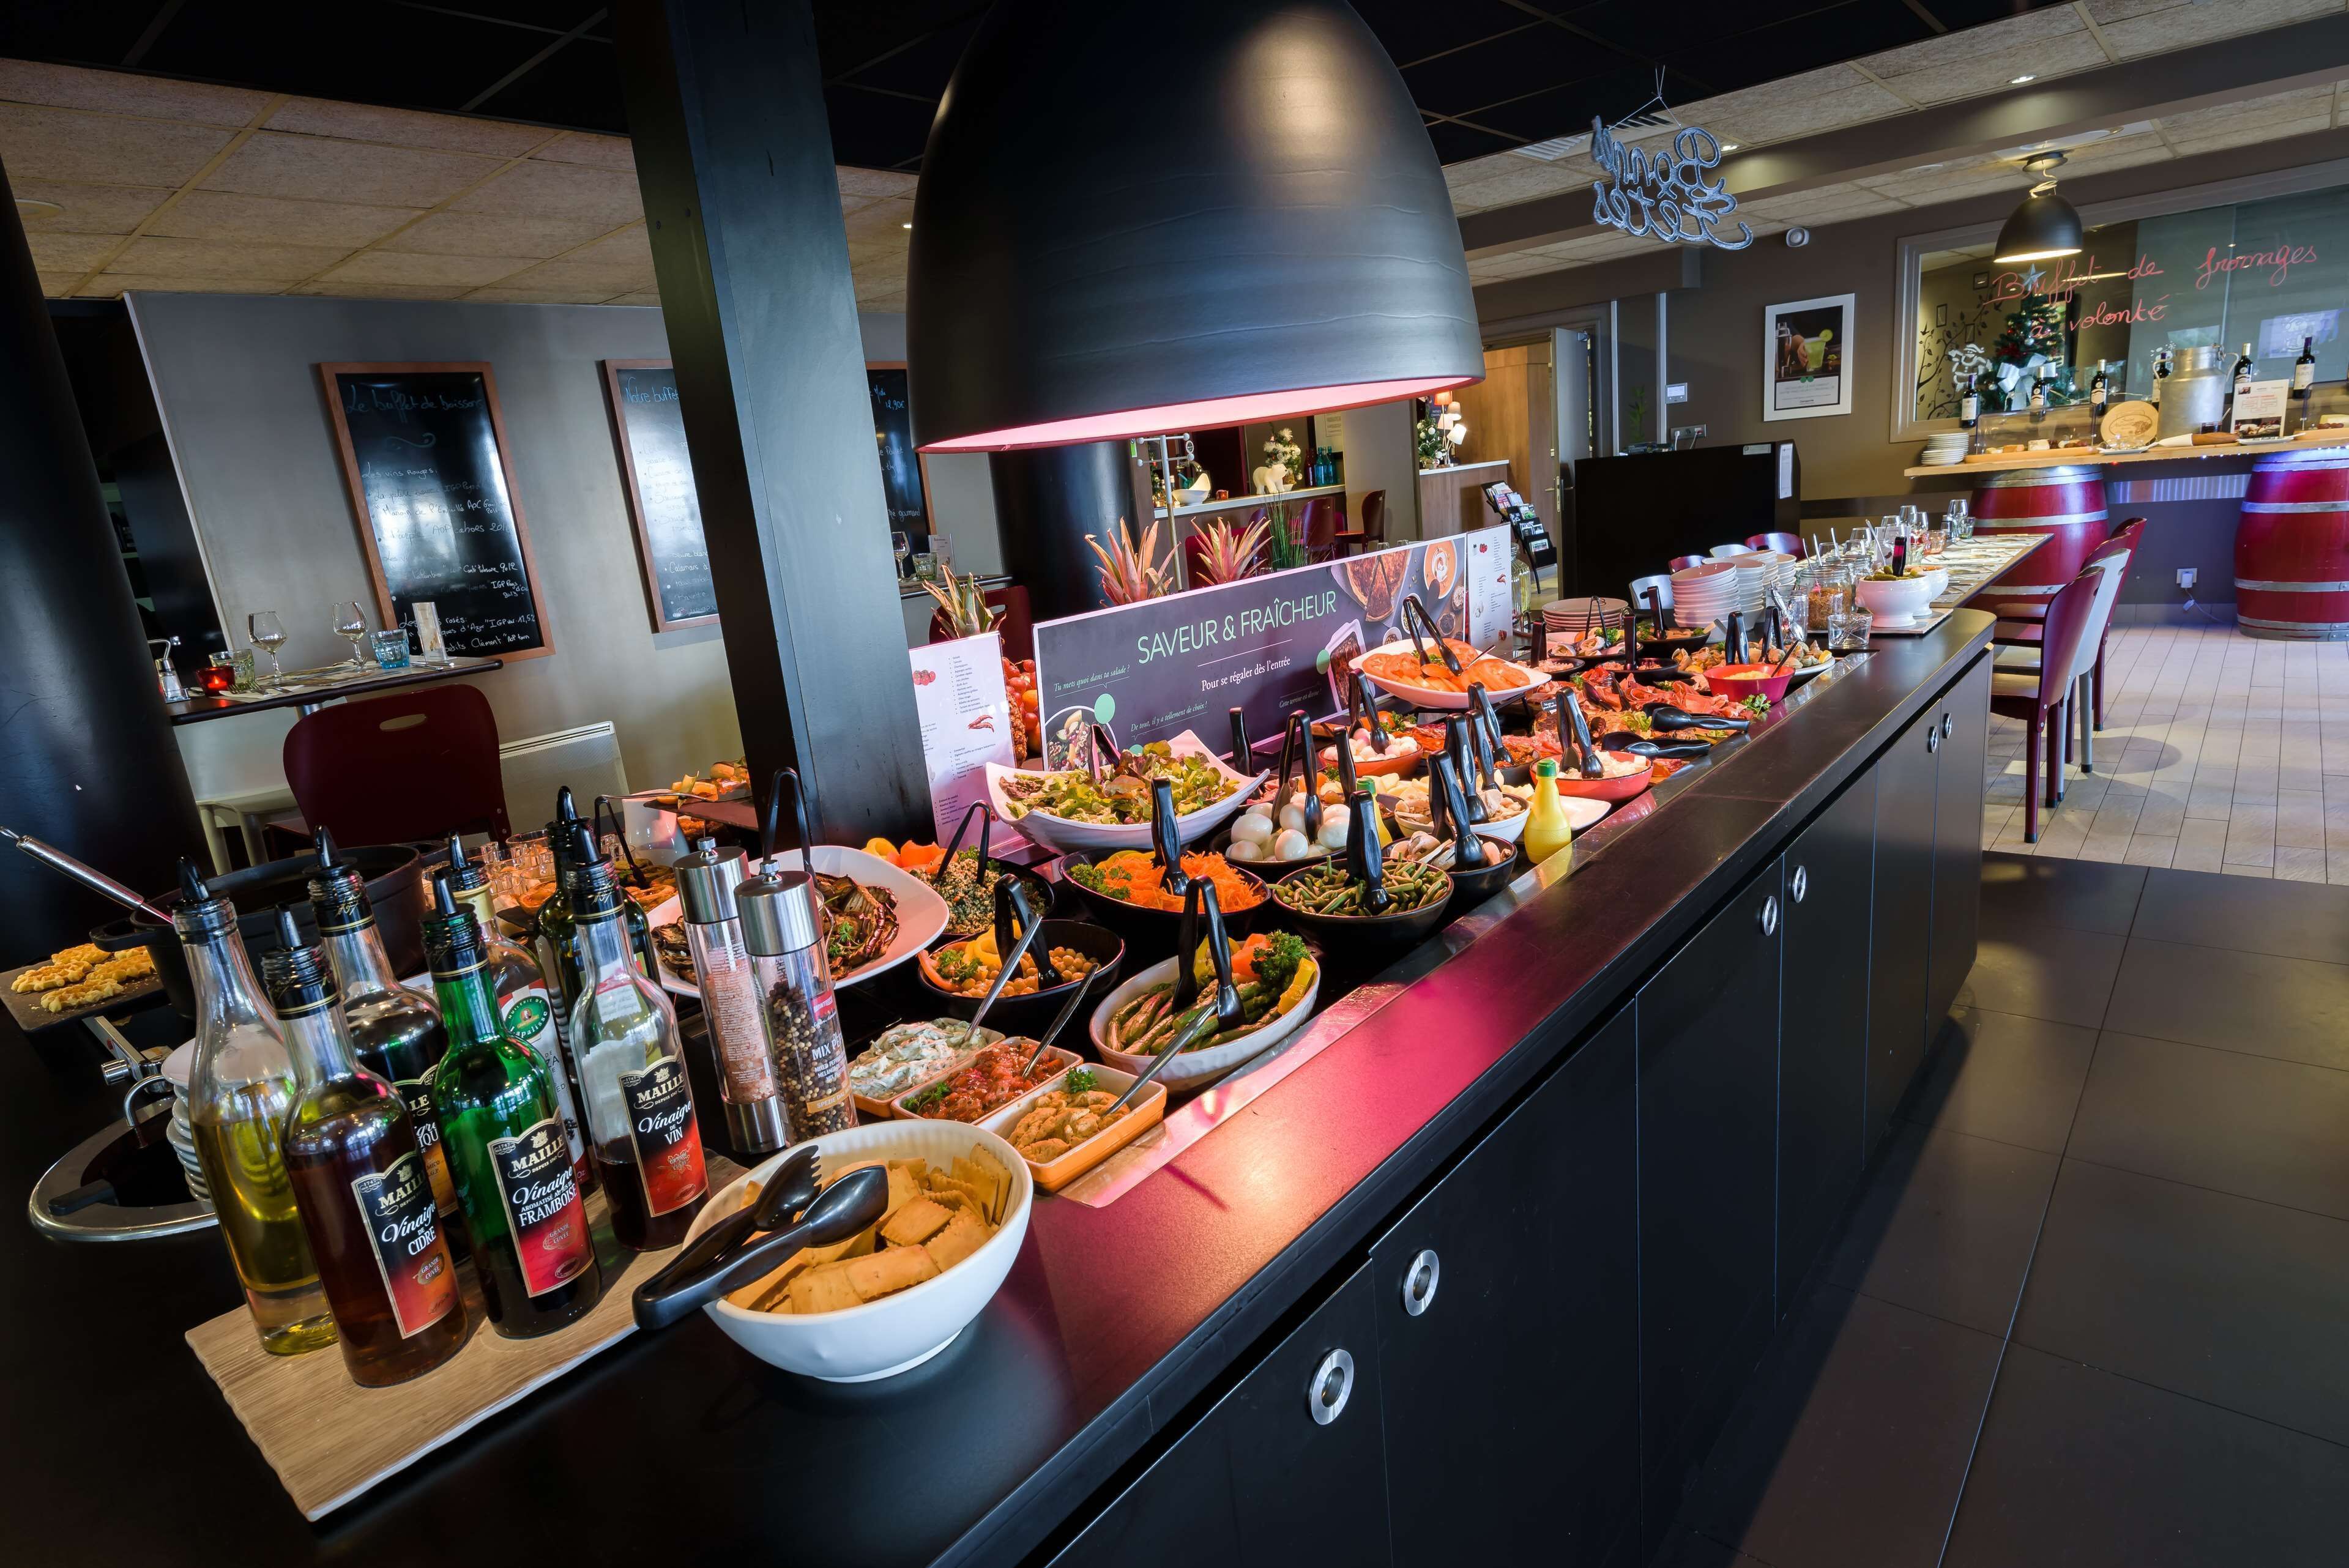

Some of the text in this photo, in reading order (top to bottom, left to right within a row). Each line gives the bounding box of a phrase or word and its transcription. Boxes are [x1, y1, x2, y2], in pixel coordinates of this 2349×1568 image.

[1982, 244, 2317, 306] Buffet de fromages
[2030, 294, 2172, 339] à volonté
[625, 376, 651, 403] Notre
[385, 469, 404, 478] vins
[1137, 590, 1337, 664] SAVEUR & FRAÎCHEUR
[1054, 682, 1062, 692] Tu
[1063, 679, 1075, 689] mets
[1076, 675, 1089, 688] quoi
[1090, 671, 1103, 683] dans
[1111, 665, 1126, 677] salade
[1201, 656, 1291, 691] Pour se régaler dès l'entrée
[1131, 723, 1139, 732] De
[1164, 708, 1186, 722] tellement
[1186, 706, 1192, 715] de
[1192, 702, 1205, 713] choix
[507, 997, 534, 1020] HUILERIE
[510, 1009, 549, 1038] Lapalisse
[812, 1042, 831, 1061] MIX
[637, 1072, 685, 1103] MAILLE
[639, 1101, 692, 1134] Vinaigre
[664, 1126, 683, 1146] VIN
[512, 1134, 564, 1172] MAILLE
[378, 1169, 426, 1209] MAILL
[513, 1165, 573, 1205] Vinaigre
[519, 1183, 578, 1227] FRAMBOISE
[381, 1200, 436, 1243] Vinaigr
[418, 1227, 425, 1236] DE
[549, 1224, 570, 1238] GRANDE
[408, 1226, 437, 1255] CIDRE
[421, 1255, 440, 1274] GRANDE
